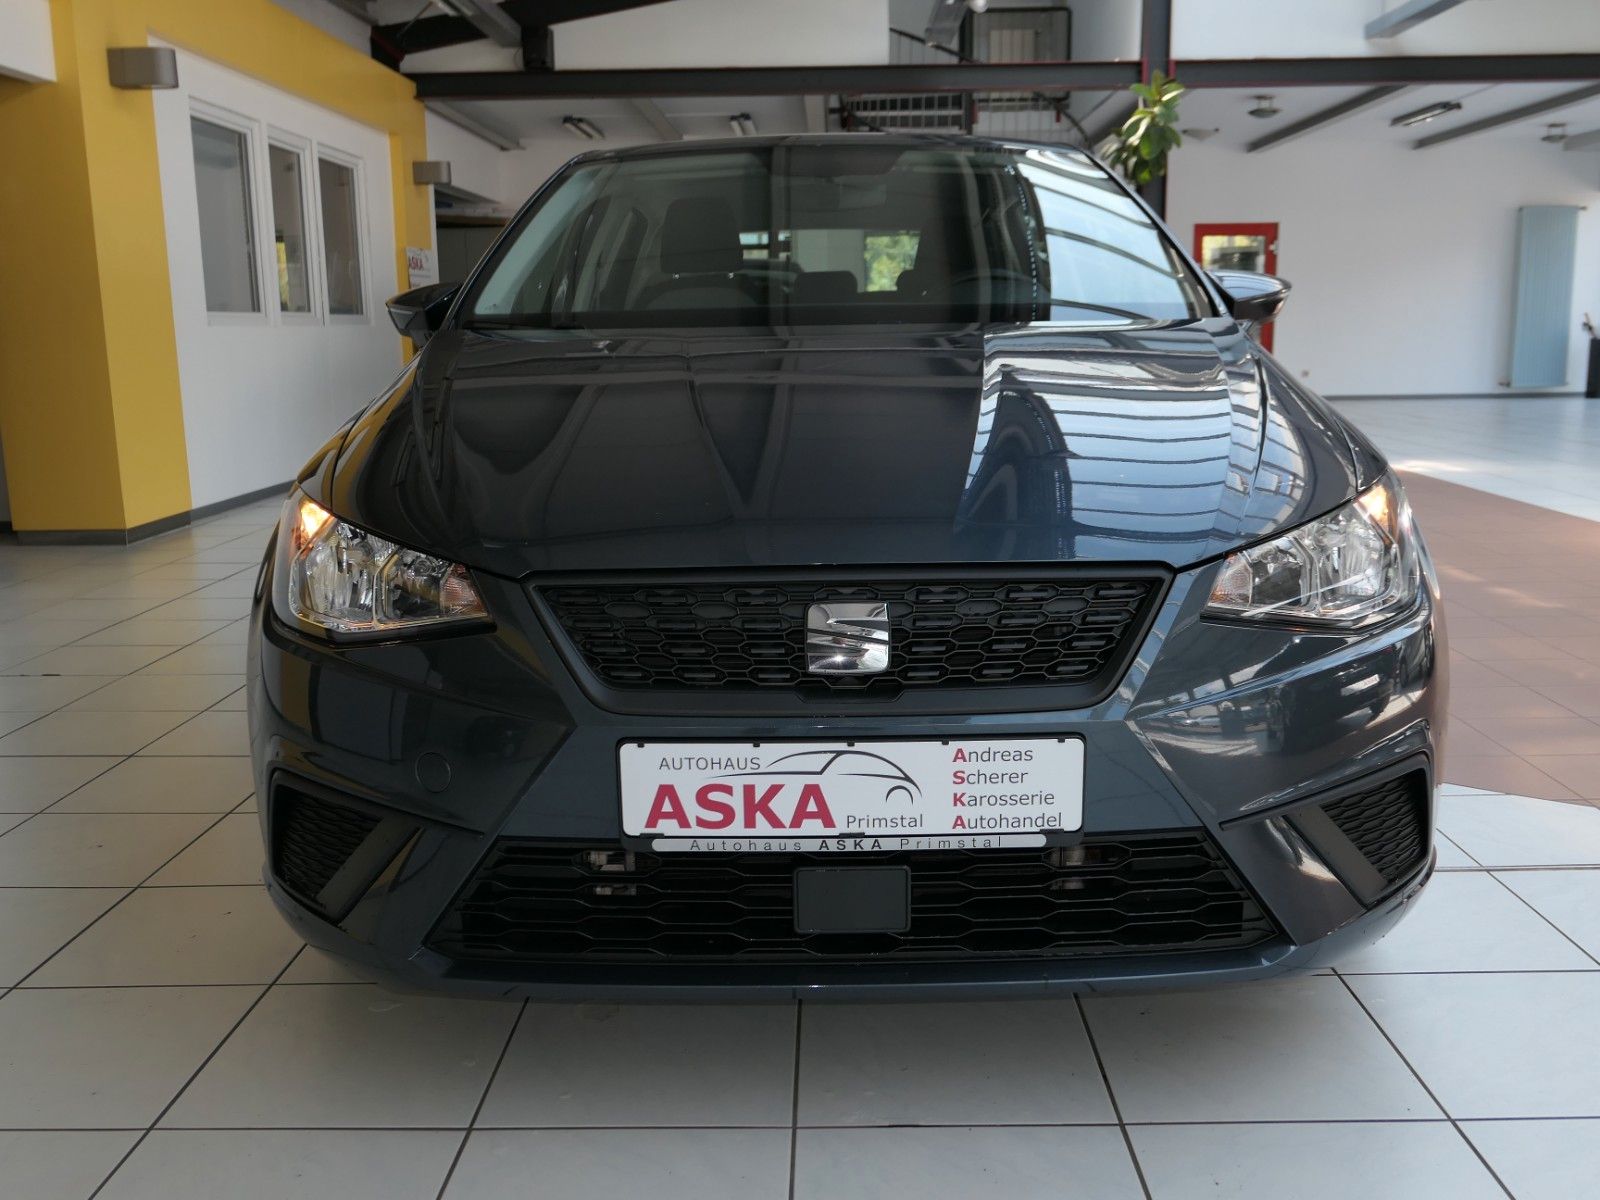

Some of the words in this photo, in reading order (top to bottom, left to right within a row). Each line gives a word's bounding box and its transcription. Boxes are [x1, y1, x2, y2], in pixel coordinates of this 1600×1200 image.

[952, 748, 1034, 763] Andreas
[659, 757, 761, 771] AUTOHAUS
[952, 770, 1028, 785] Scherer
[644, 783, 837, 829] ASKA
[952, 791, 1055, 807] Karosserie
[846, 814, 923, 829] Primstal
[952, 812, 1062, 830] Autohandel
[690, 839, 802, 851] Autohaus
[818, 839, 882, 851] ASKA
[900, 836, 1001, 849] Primstal
